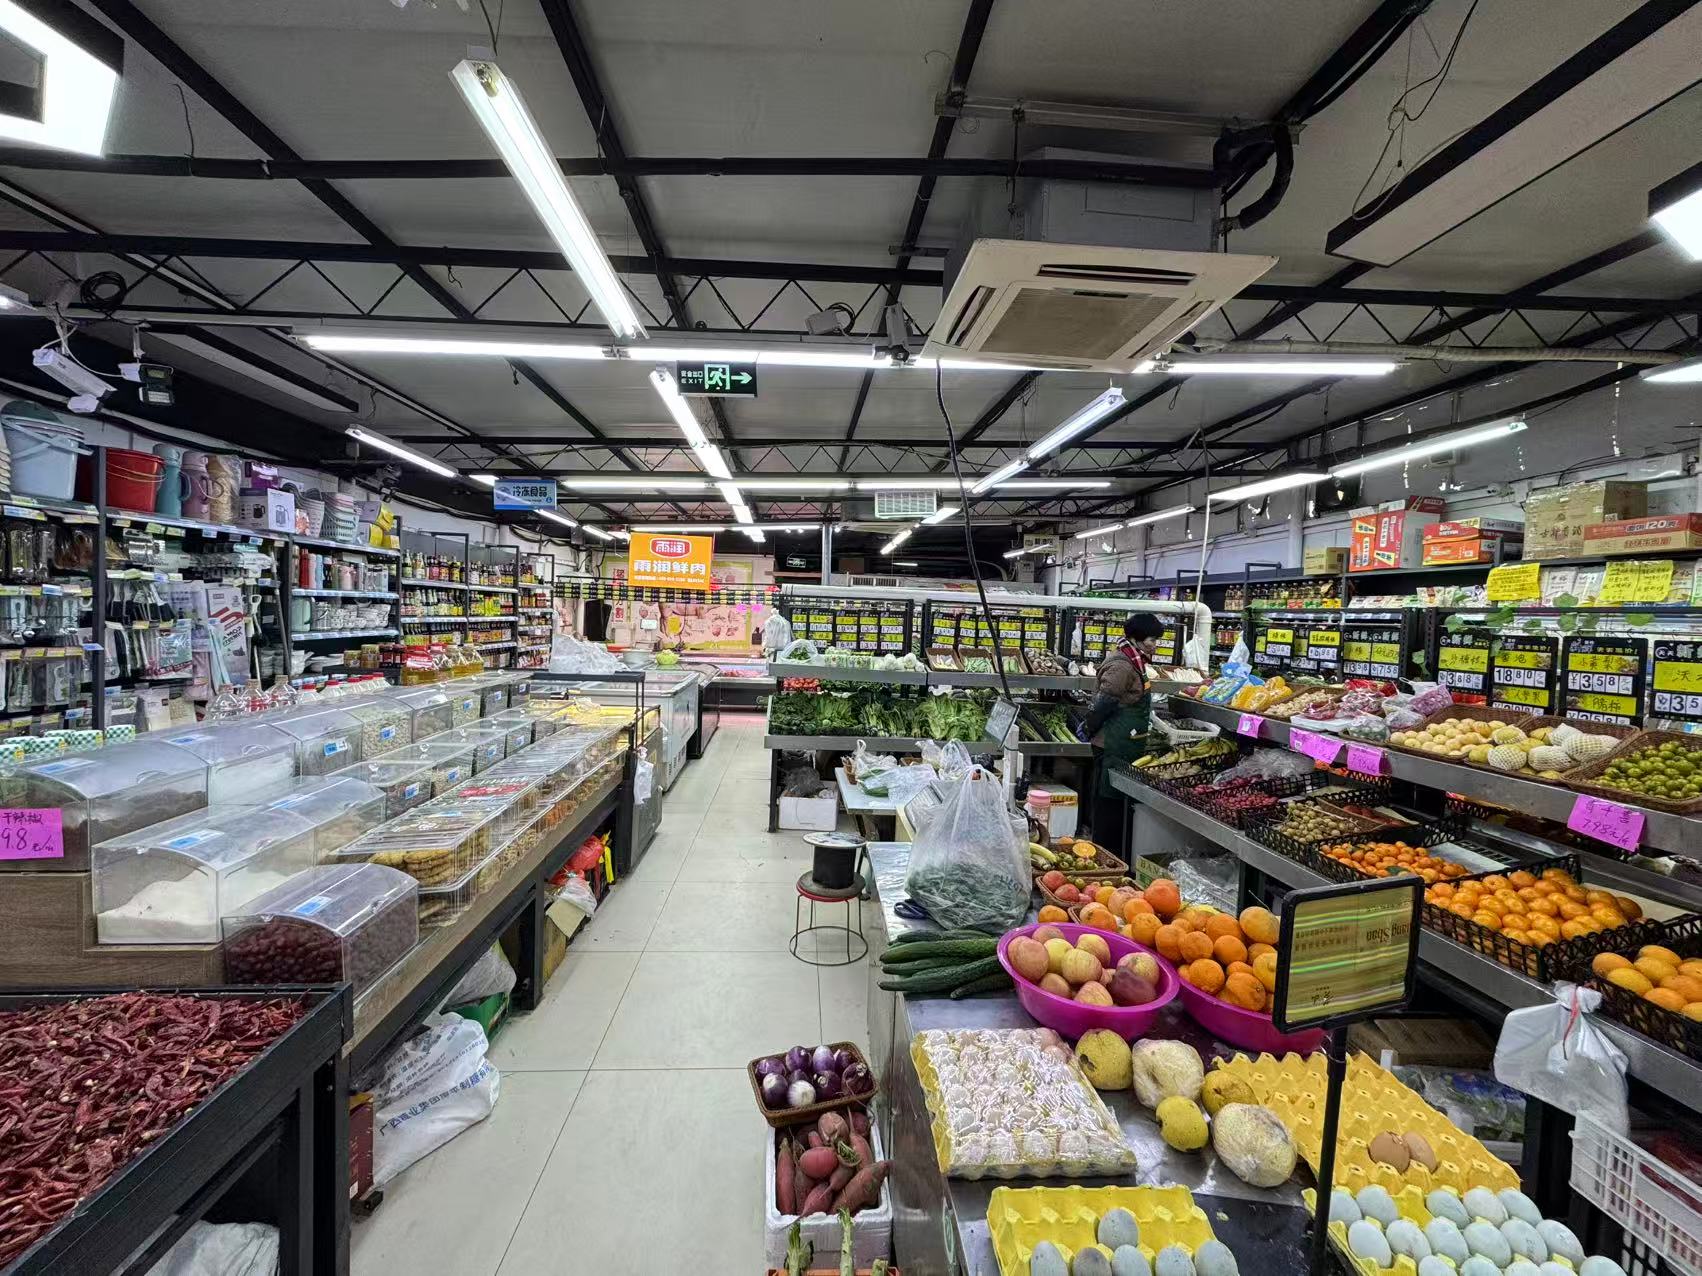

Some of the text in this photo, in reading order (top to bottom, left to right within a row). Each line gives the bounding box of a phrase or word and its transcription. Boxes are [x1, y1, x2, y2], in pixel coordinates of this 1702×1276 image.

[512, 485, 548, 498] 冷冻食品
[633, 559, 706, 576] 雨润鲜肉
[1672, 669, 1702, 682] 沃
